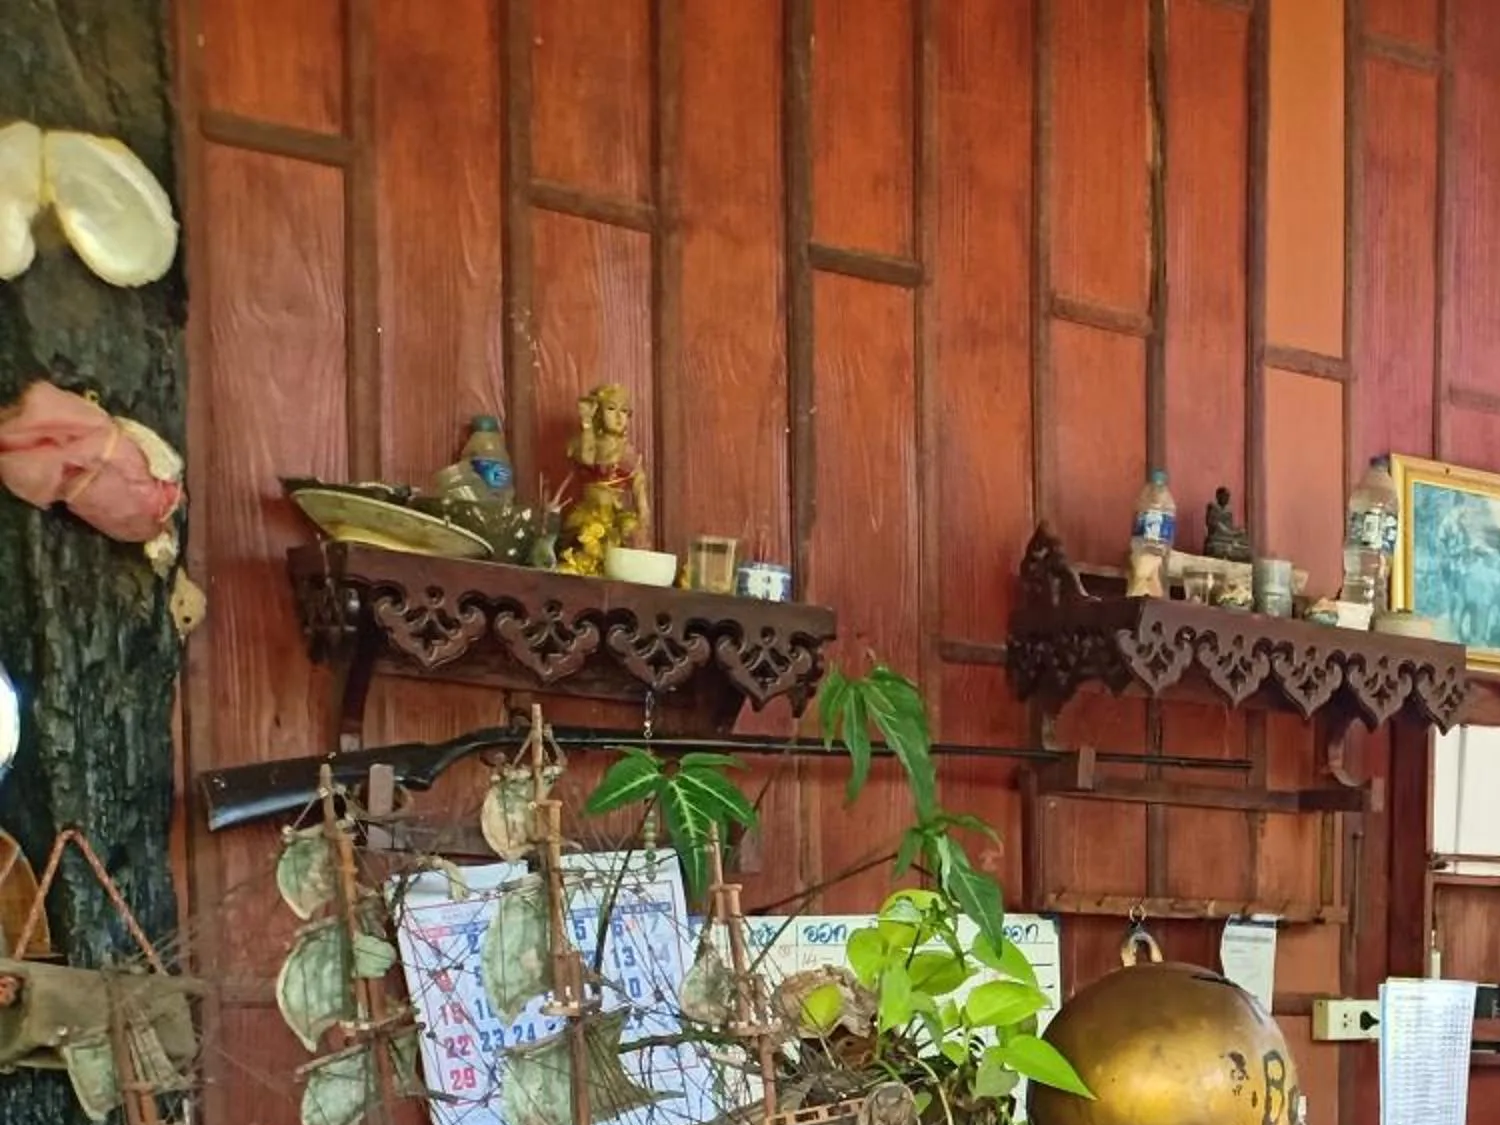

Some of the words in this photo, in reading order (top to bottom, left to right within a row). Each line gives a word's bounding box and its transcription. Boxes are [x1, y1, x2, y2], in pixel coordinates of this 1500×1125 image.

[573, 920, 587, 941] 5
[444, 1034, 472, 1059] 22
[480, 1028, 505, 1051] 23
[513, 1023, 536, 1042] 24
[450, 1066, 477, 1091] 29
